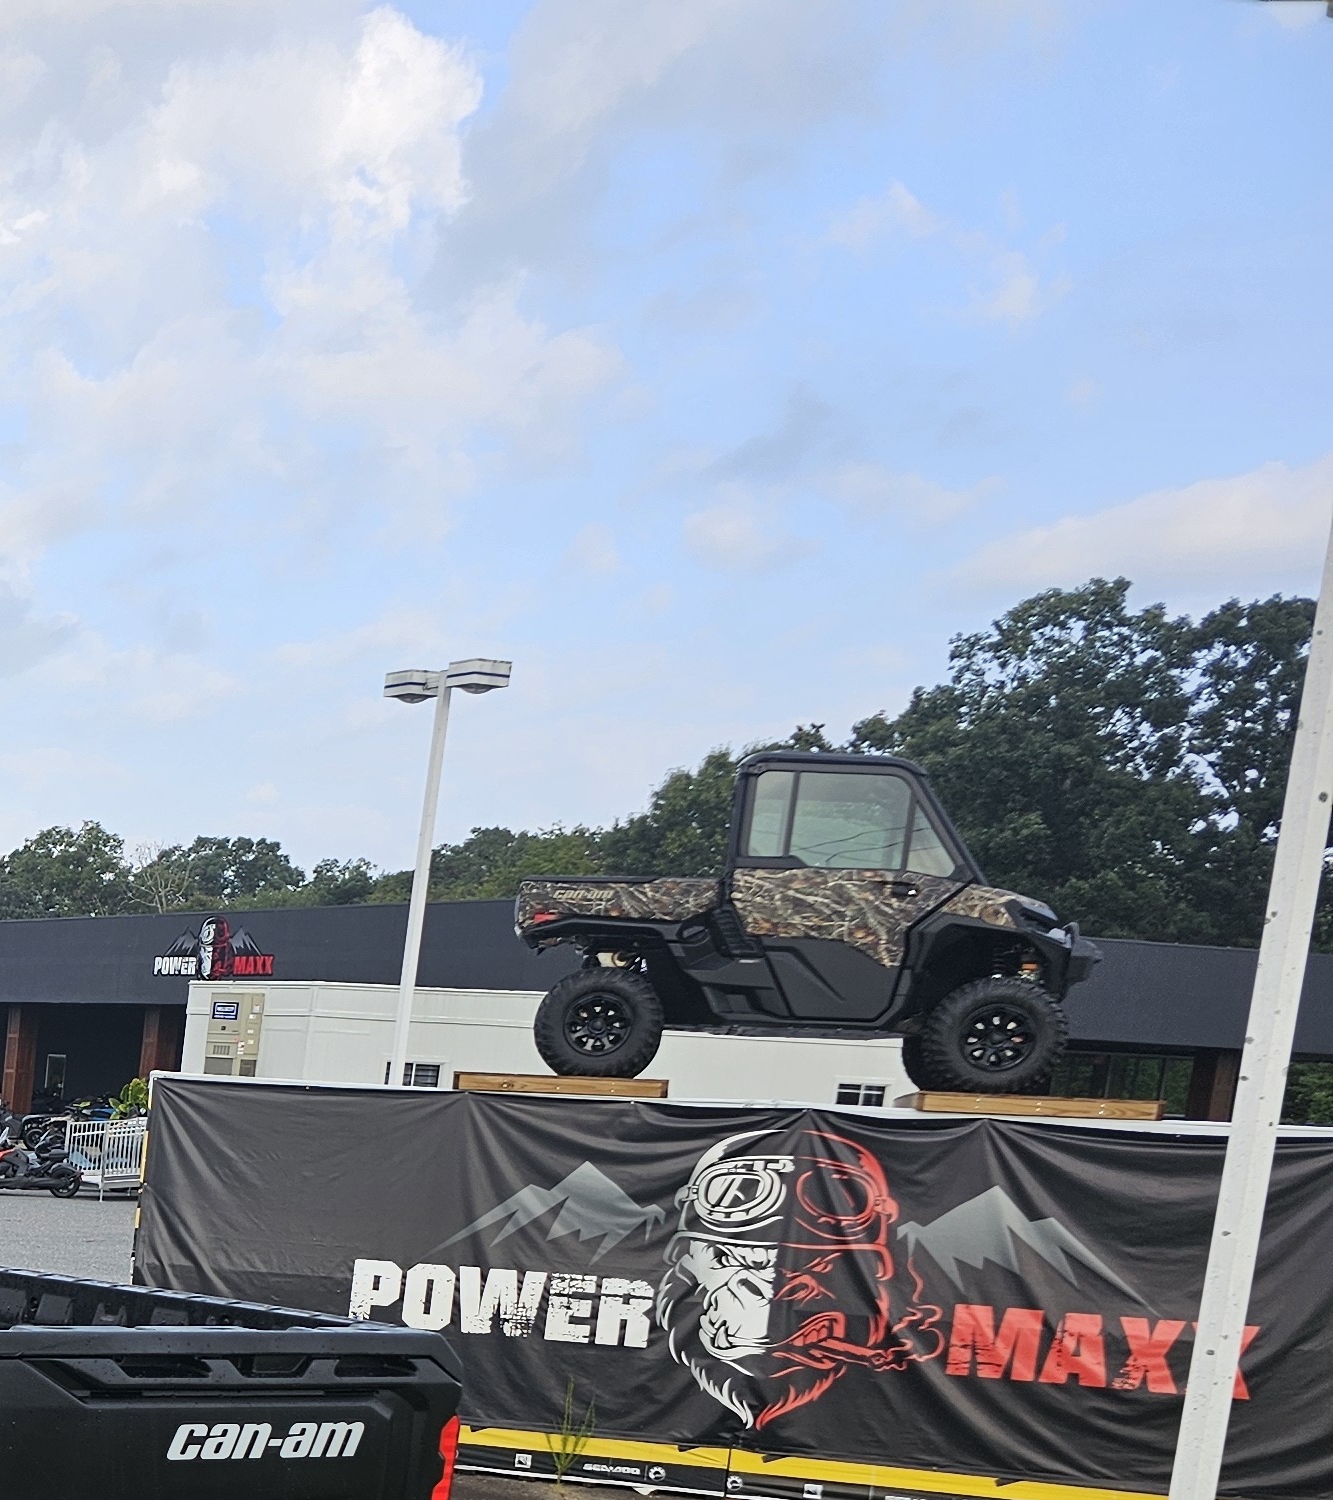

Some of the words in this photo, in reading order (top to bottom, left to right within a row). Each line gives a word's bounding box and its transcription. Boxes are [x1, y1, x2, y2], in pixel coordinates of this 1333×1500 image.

[153, 956, 197, 976] POWER
[233, 956, 274, 975] MAXX
[348, 1258, 655, 1348] POWER
[166, 1421, 365, 1461] can-am
